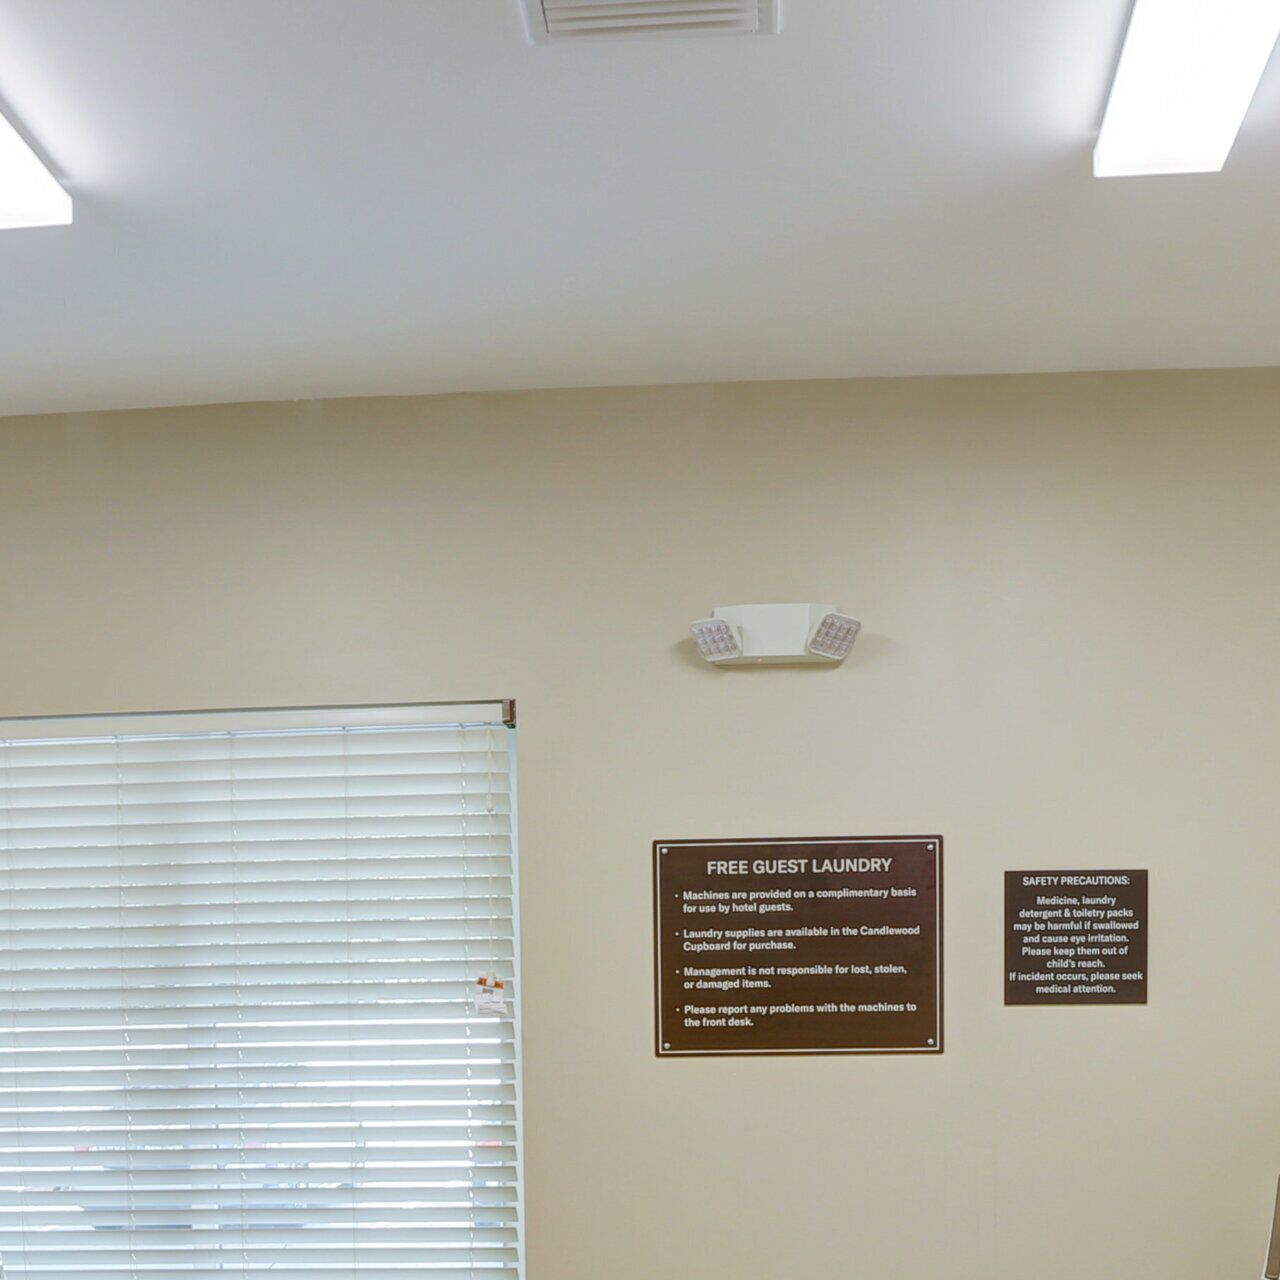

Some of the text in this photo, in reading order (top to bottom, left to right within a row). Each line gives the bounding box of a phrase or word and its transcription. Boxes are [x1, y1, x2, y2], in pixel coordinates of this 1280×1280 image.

[707, 858, 892, 875] FREE GUEST LAUNDRY
[1022, 875, 1130, 886] SAFETY PRECAUTIONS:
[683, 890, 730, 900] Machines
[731, 892, 748, 900] are
[749, 889, 792, 901] provided
[808, 890, 815, 898] a
[816, 887, 889, 900] complimentary
[891, 887, 917, 897] basis
[1037, 895, 1117, 907] Medicine, laundry
[683, 902, 794, 914] for use by hotel guests.
[1019, 908, 1134, 920] detergent & toiletry packs
[683, 925, 920, 940] Laundry supplies are available in the Candlewood
[1013, 920, 1139, 933] may be harmful if swallowed
[1023, 933, 1129, 945] and cause eye irritation.
[683, 940, 796, 953] Cupboard for purchase.
[1022, 946, 1128, 958] Please keep them out of
[1046, 959, 1106, 968] child's reach.
[684, 964, 907, 978] Management is not responsible for lost, stolen,
[1009, 971, 1143, 982] If incident occurs, please seek
[683, 979, 772, 991] or damaged items.
[1036, 984, 1116, 994] medical attention.
[684, 1003, 917, 1016] Please report any problems with the machines to
[684, 1017, 754, 1027] the front desk.
